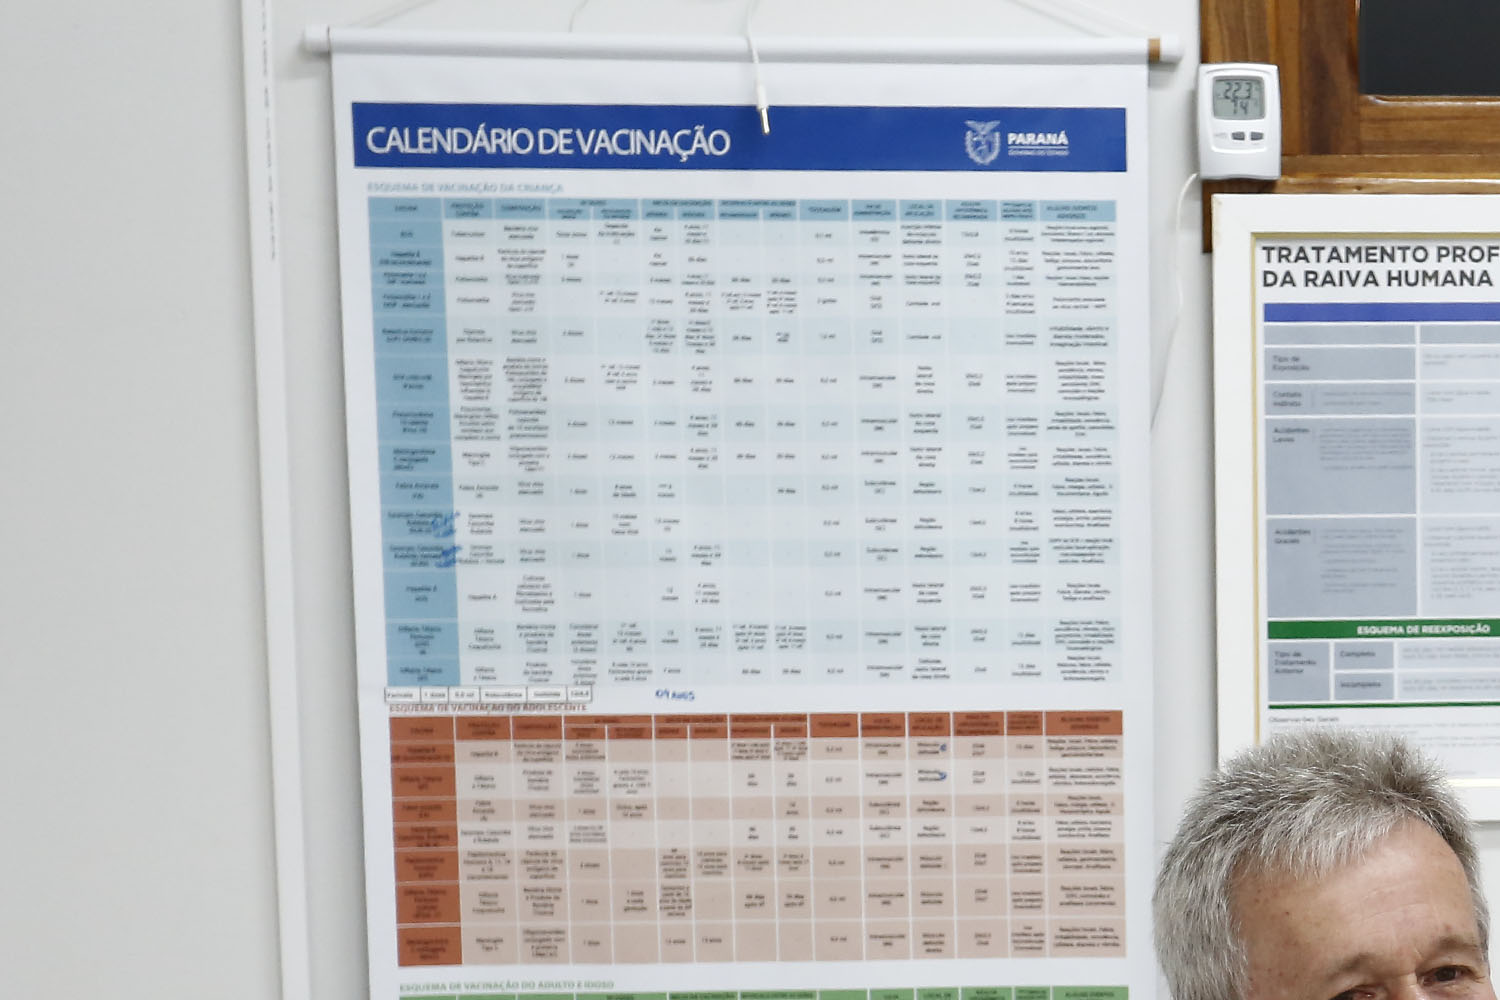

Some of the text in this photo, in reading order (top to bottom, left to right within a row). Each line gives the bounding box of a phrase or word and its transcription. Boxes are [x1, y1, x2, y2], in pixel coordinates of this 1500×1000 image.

[366, 122, 731, 162] CALENDÁRIO DE VACINAÇÃO
[1007, 130, 1069, 145] PARANÁ
[1262, 245, 1429, 264] TRATAMENTO
[1262, 269, 1494, 288] DA RAIVA HUMANA
[1357, 625, 1404, 635] ESQUEMA
[1406, 625, 1420, 635] DE
